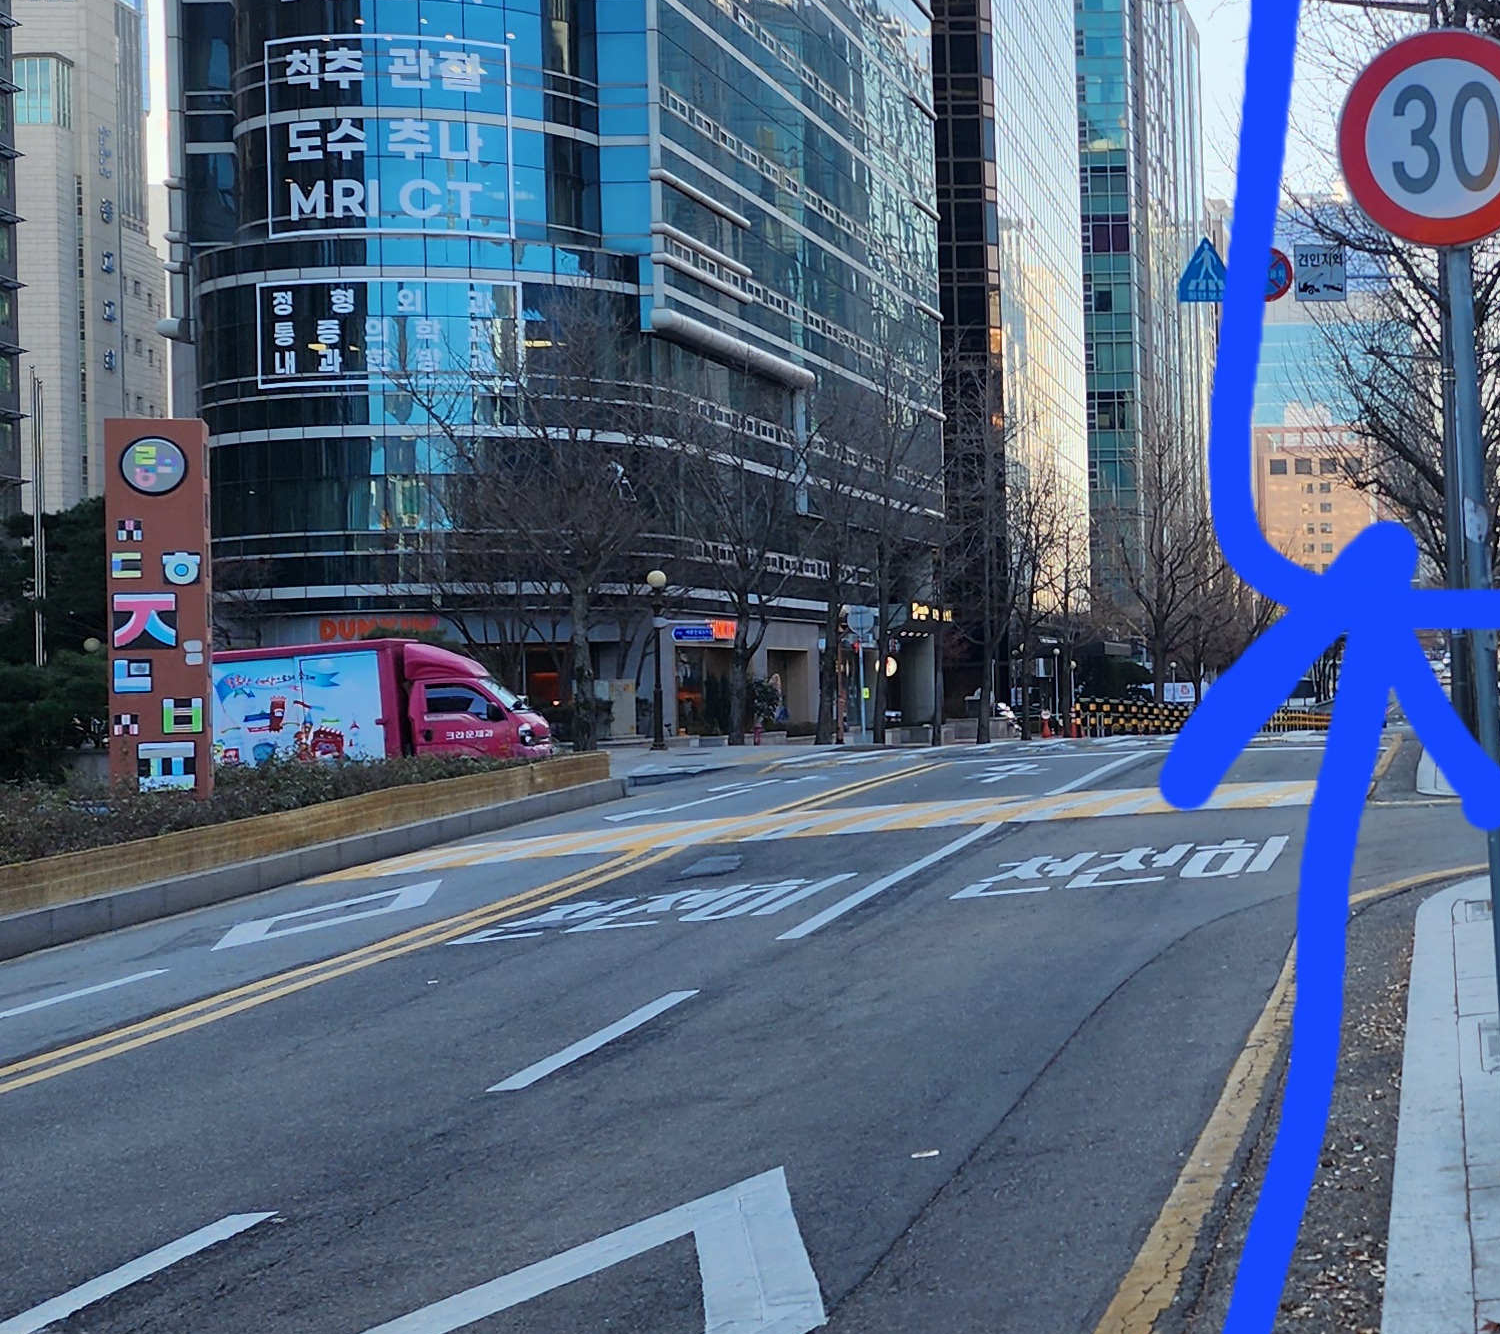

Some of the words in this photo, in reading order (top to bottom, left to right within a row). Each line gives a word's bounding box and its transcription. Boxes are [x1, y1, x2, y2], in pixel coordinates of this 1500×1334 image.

[286, 47, 364, 90] 척추
[388, 47, 482, 93] 관절
[288, 118, 367, 161] 도수
[387, 118, 483, 164] 추나
[1392, 81, 1500, 194] 30
[290, 179, 379, 221] MRI
[399, 179, 483, 221] CT
[950, 835, 1290, 900] 천천히
[445, 872, 858, 946] 천천히
